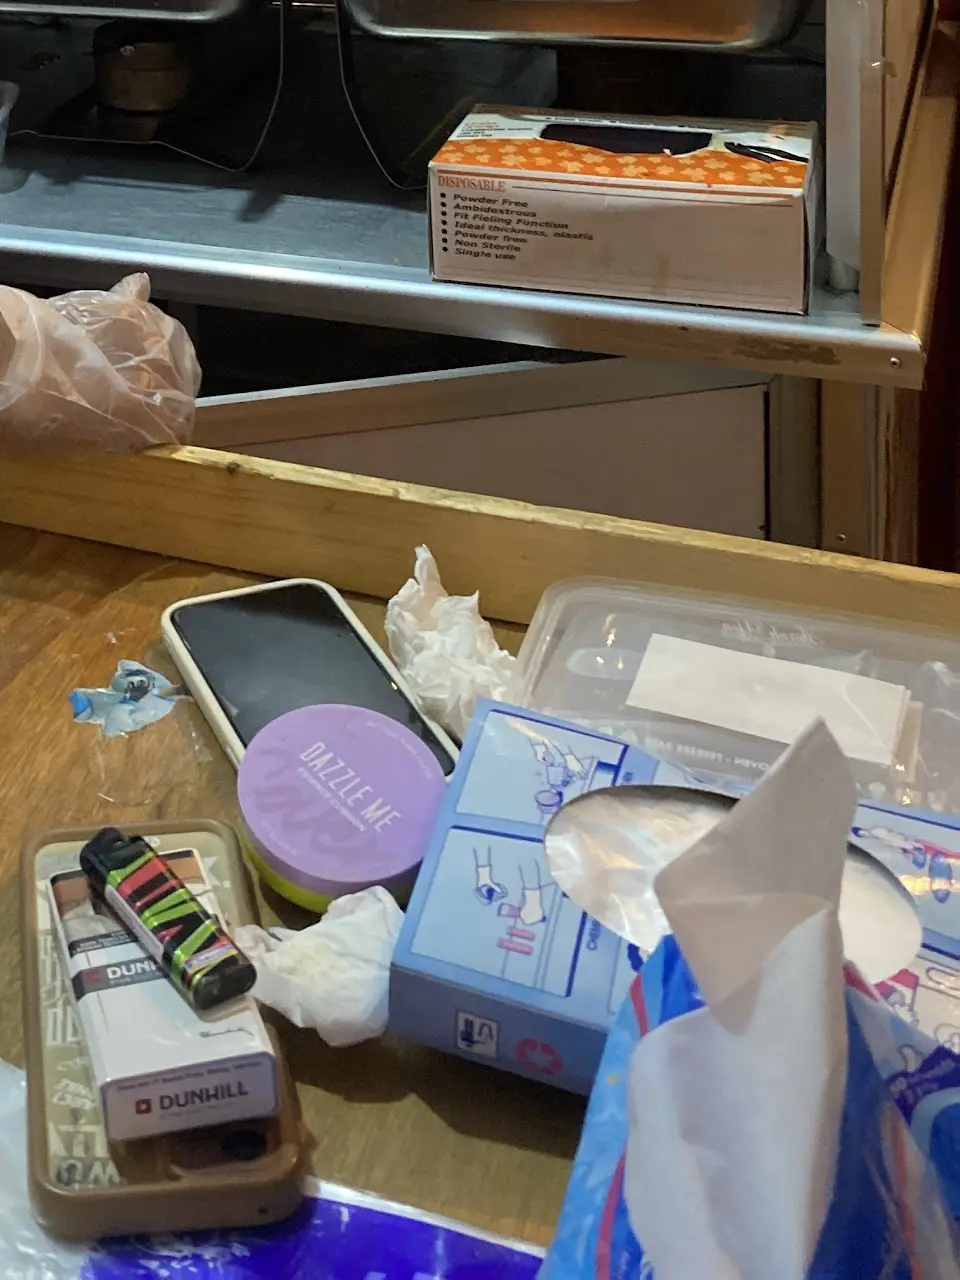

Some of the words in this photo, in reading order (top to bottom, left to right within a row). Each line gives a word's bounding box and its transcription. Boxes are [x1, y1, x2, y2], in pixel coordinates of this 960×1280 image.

[437, 175, 506, 192] DISPOSABLE
[453, 193, 498, 204] Powder
[501, 198, 528, 208] Free
[453, 203, 537, 217] Ambidextrous
[453, 212, 469, 220] Fit
[516, 218, 569, 229] Function
[454, 221, 484, 231] Ideal
[454, 230, 499, 241] Powder
[454, 239, 478, 248] Non
[482, 241, 521, 252] Sterile
[455, 247, 491, 259] Single
[495, 252, 516, 261] use
[299, 741, 375, 807] DAZZLE
[360, 797, 401, 834] ME
[159, 1081, 249, 1111] DUNHILL
